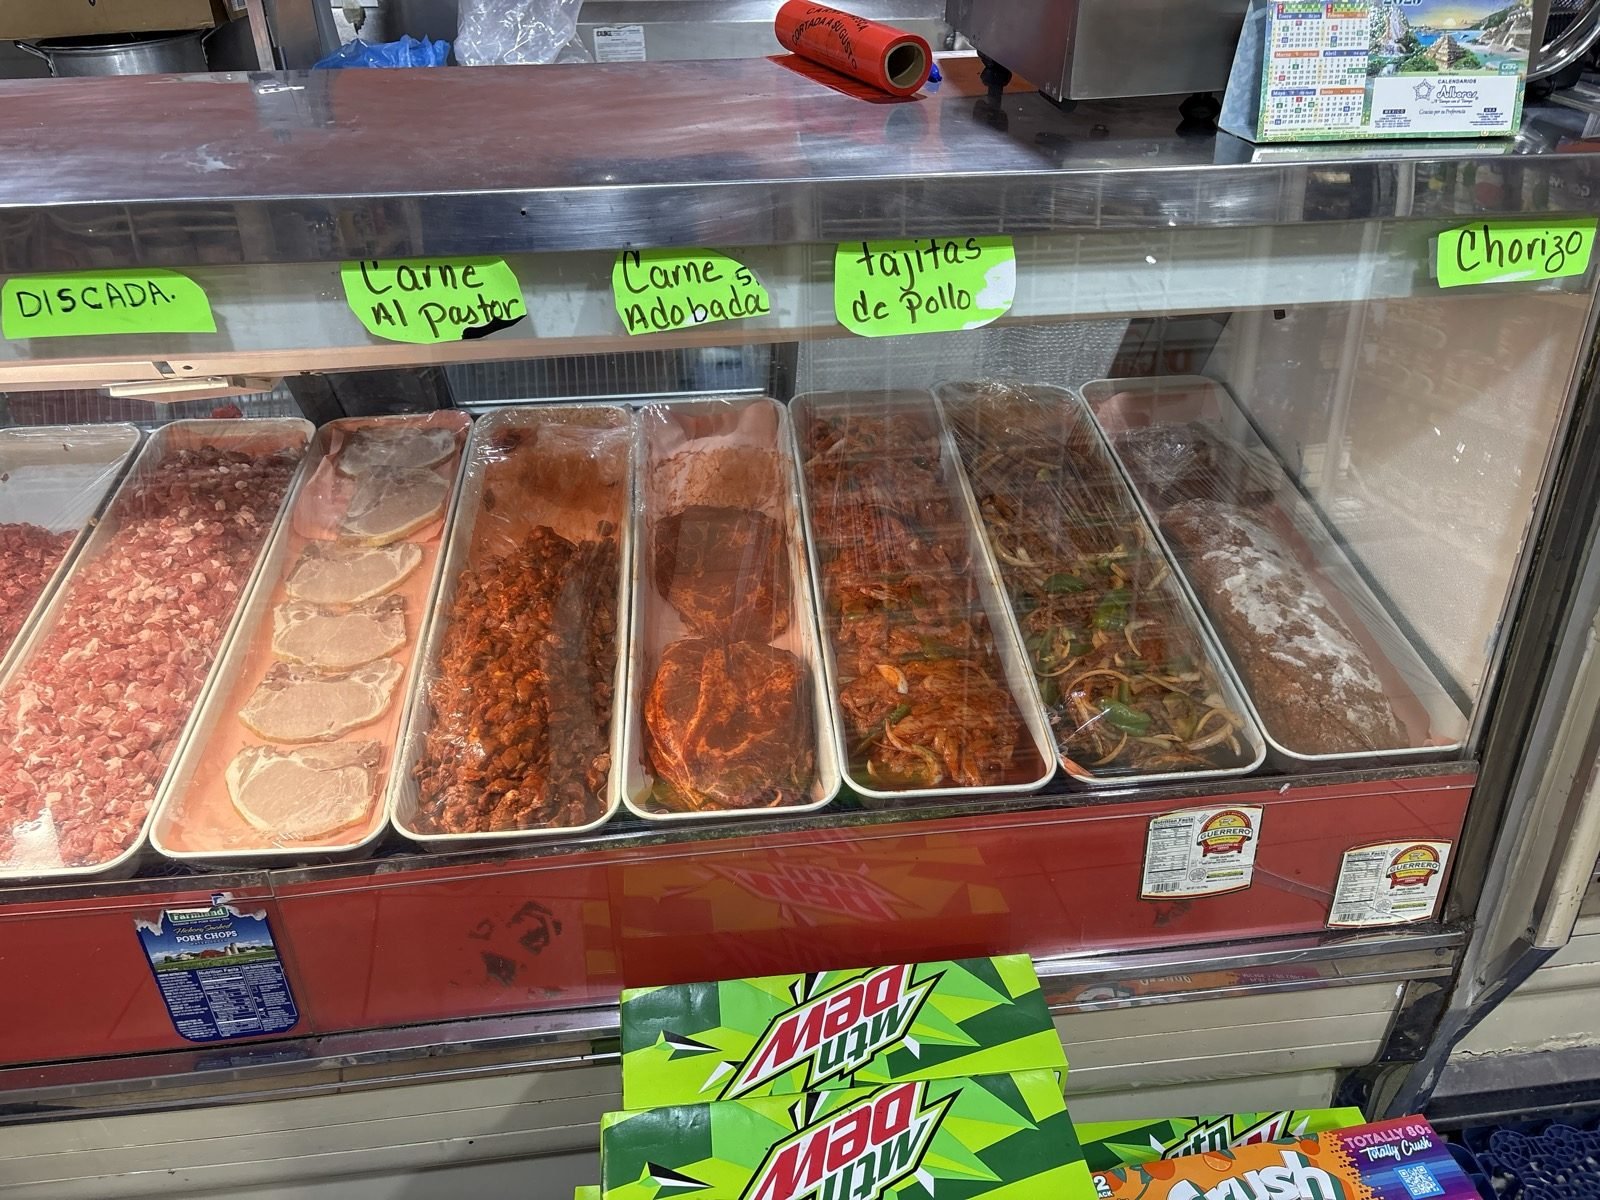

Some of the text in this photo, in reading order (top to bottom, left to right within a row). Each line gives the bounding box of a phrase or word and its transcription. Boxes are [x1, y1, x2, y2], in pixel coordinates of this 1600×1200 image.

[791, 17, 827, 46] CORTADA
[1456, 224, 1583, 273] Chorizo
[359, 260, 485, 295] Carne
[622, 249, 724, 294] Carne
[16, 280, 176, 318] DISCADA.
[370, 298, 409, 327] Al
[624, 284, 770, 332] Adobada
[1200, 828, 1250, 840] GUERRERO
[1390, 862, 1438, 873] GUERRERO
[175, 934, 203, 943] PORK
[203, 930, 238, 941] CHOPS
[1343, 1124, 1432, 1149] TOTALLY 80s
[1359, 1136, 1432, 1162] Totally Crush
[1098, 1190, 1113, 1198] ACK
